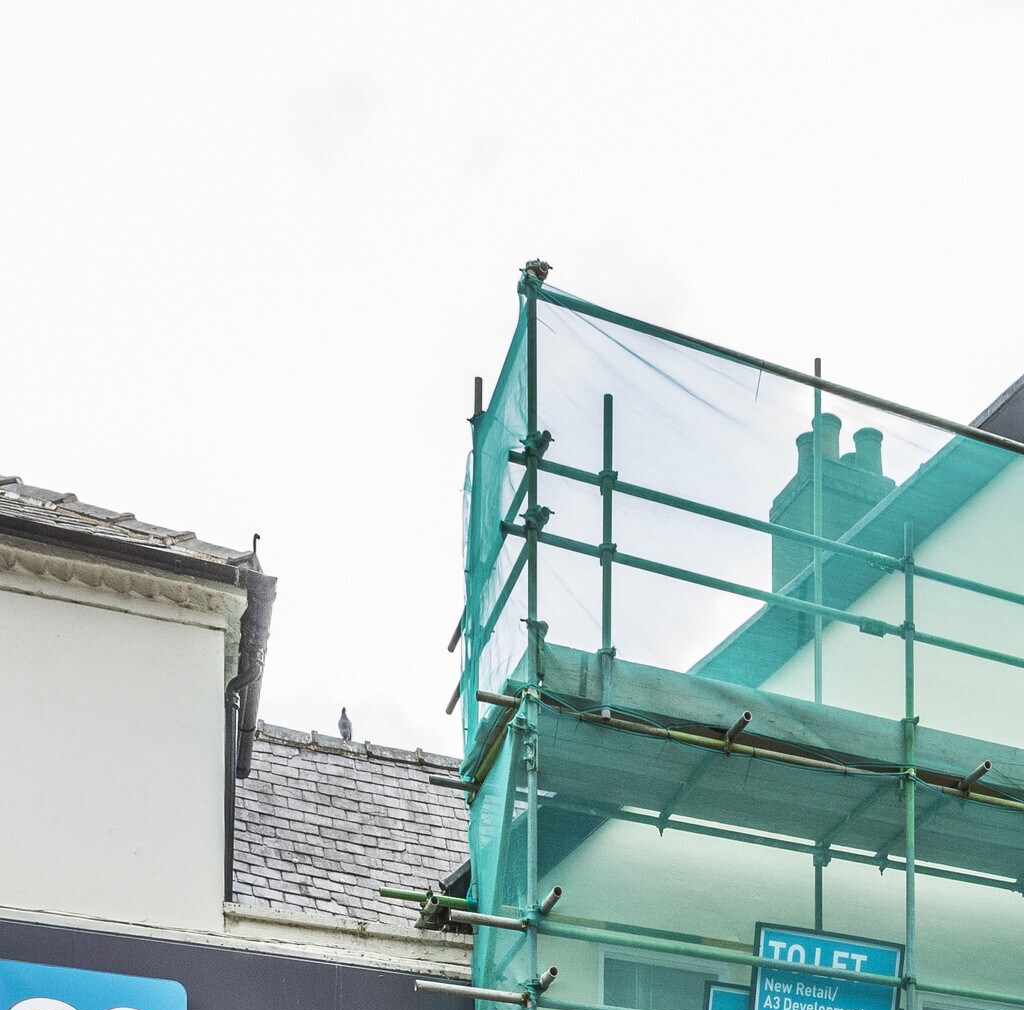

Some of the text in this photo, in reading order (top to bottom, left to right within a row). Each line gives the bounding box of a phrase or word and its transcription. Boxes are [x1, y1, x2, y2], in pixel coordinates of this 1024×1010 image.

[764, 977, 838, 1001] New Retail/
[763, 995, 780, 1010] A3
